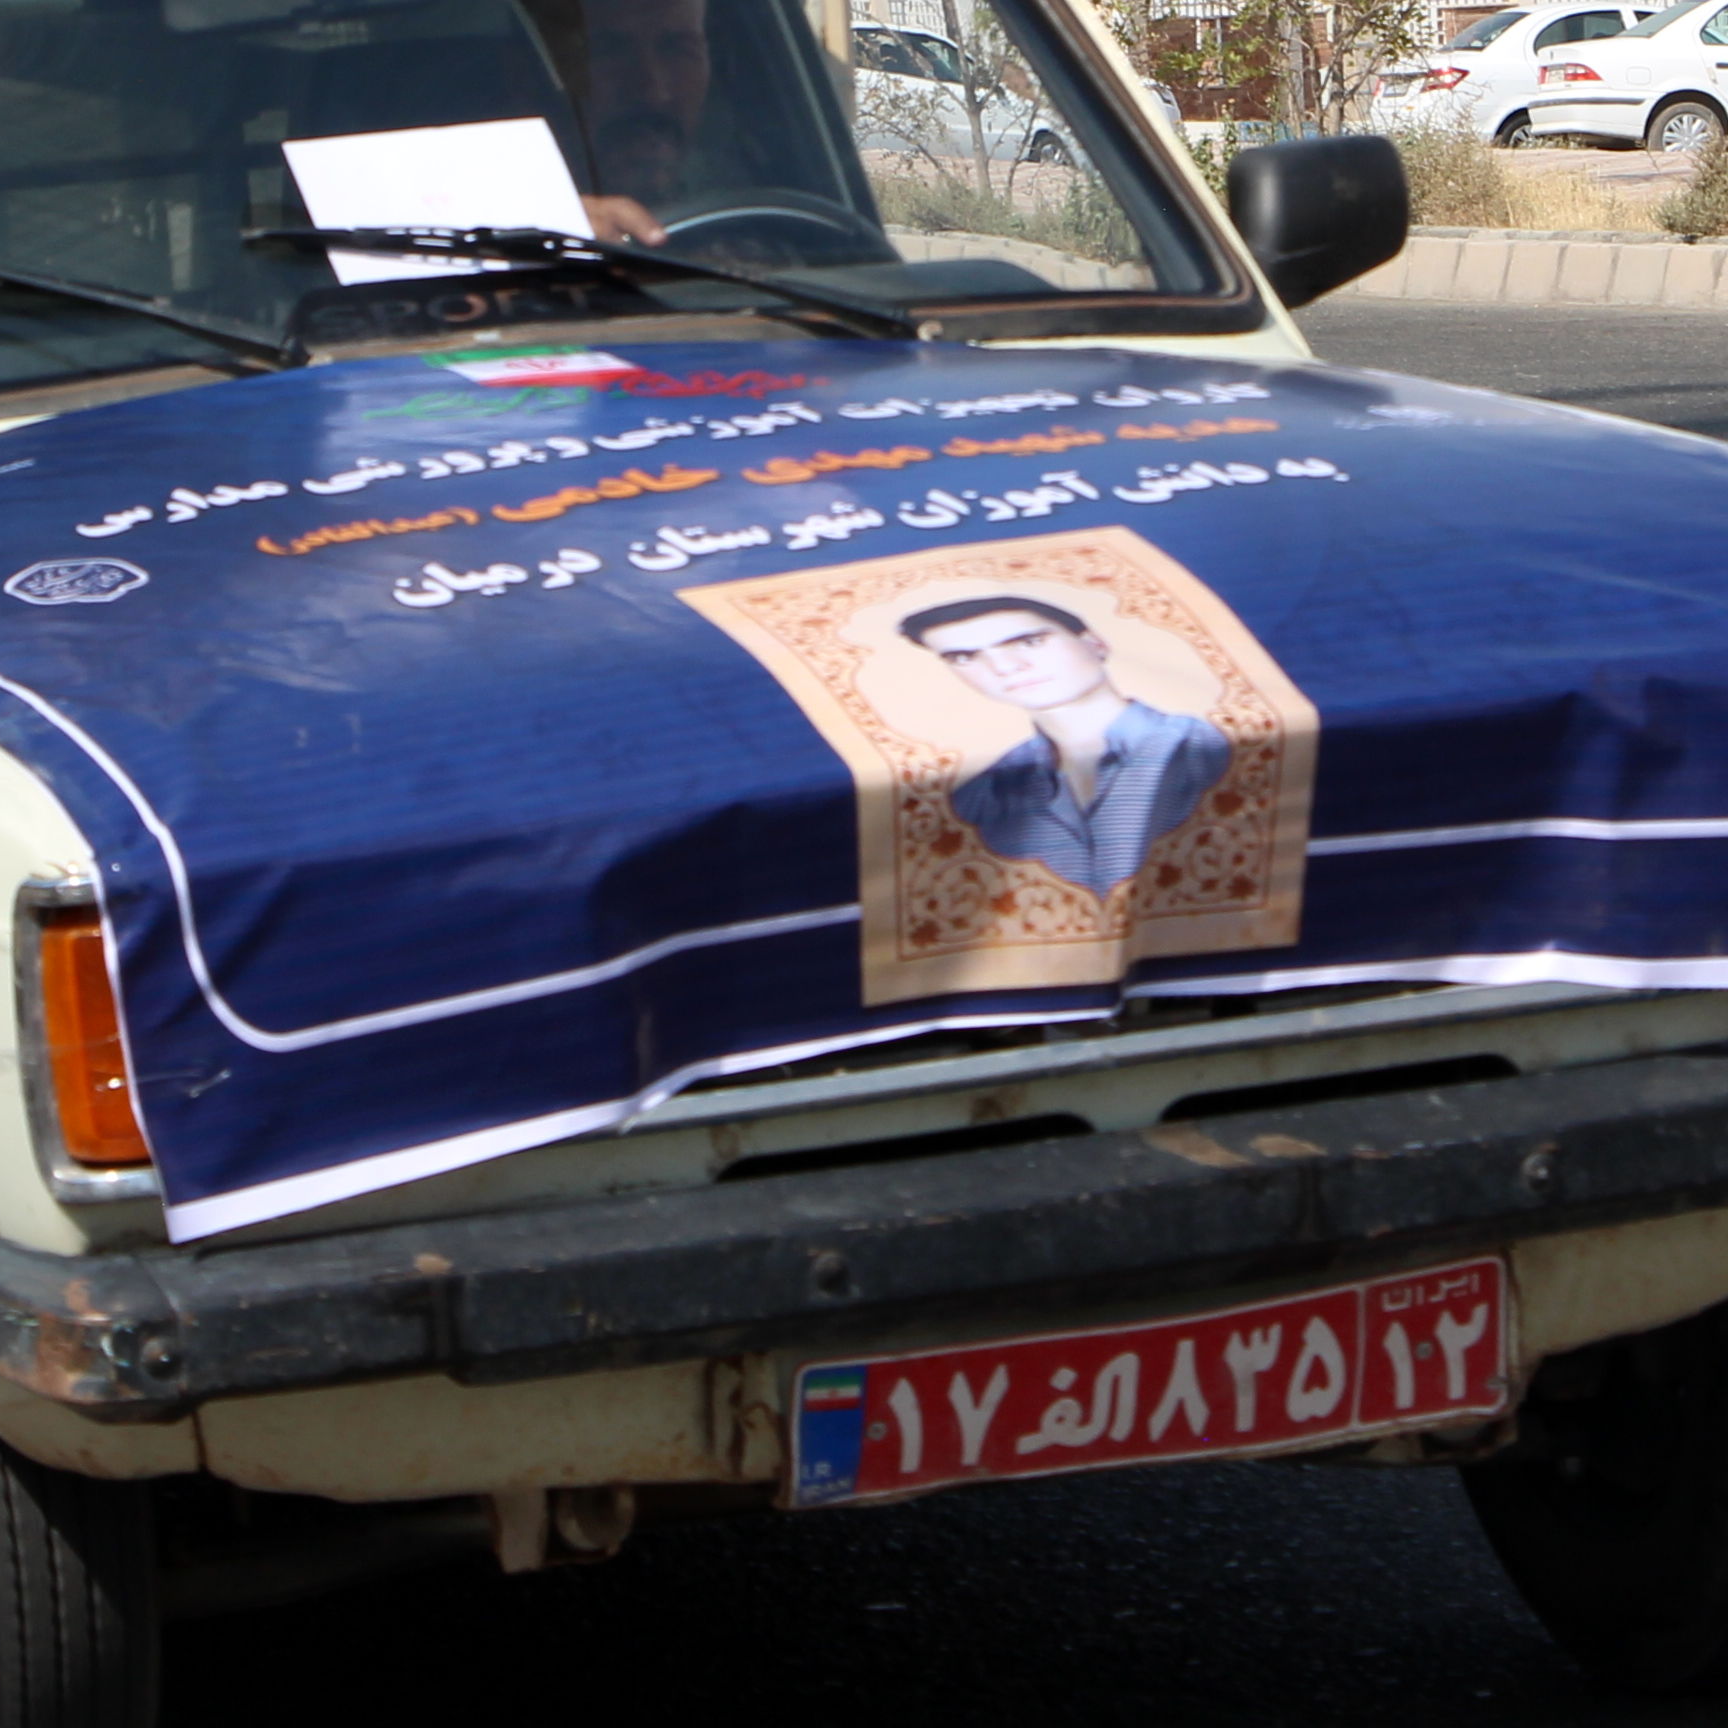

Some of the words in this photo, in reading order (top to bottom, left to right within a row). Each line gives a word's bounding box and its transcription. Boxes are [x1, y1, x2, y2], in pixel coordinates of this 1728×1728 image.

[837, 387, 1079, 420] تجهیزات
[1095, 381, 1271, 408] کاروان
[592, 401, 822, 451] آموزشی
[943, 425, 1106, 458] شهید
[742, 445, 933, 486] مهدی
[1113, 459, 1270, 505] دانش
[1275, 456, 1349, 483] به
[76, 480, 289, 539] مدارس
[491, 464, 720, 523] خادمی
[895, 469, 1100, 530] آموزان
[1380, 1272, 1481, 1314] ایران
[1381, 1300, 1489, 1411] ۱۲
